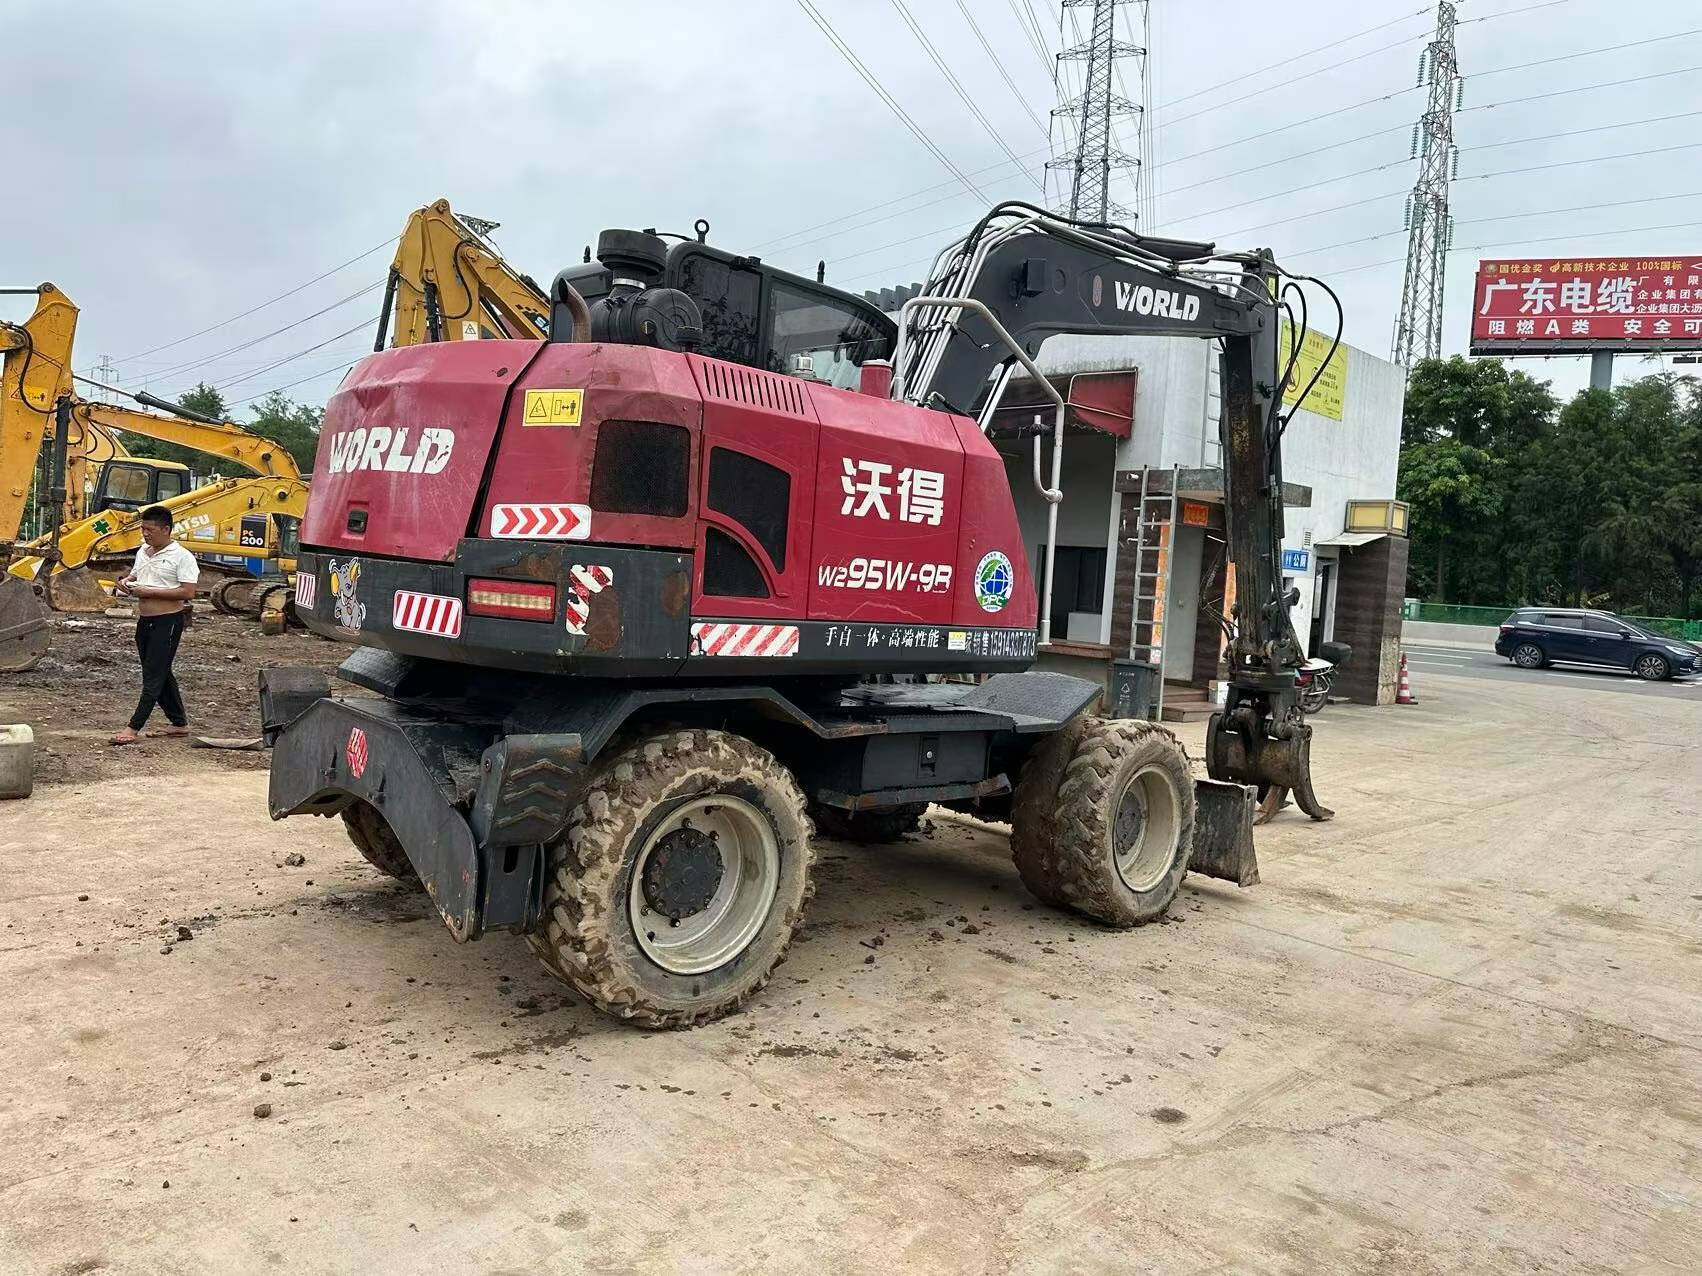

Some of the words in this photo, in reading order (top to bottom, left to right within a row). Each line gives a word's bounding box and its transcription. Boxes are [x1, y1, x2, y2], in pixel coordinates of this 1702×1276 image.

[1500, 264, 1542, 274] 国优金奖
[1562, 261, 1629, 273] 高新技术企业
[1114, 280, 1200, 322] WORLD
[1480, 277, 1637, 315] 广东电缆
[328, 426, 456, 475] WORLD
[840, 457, 945, 526] 沃得
[241, 537, 264, 546] 200
